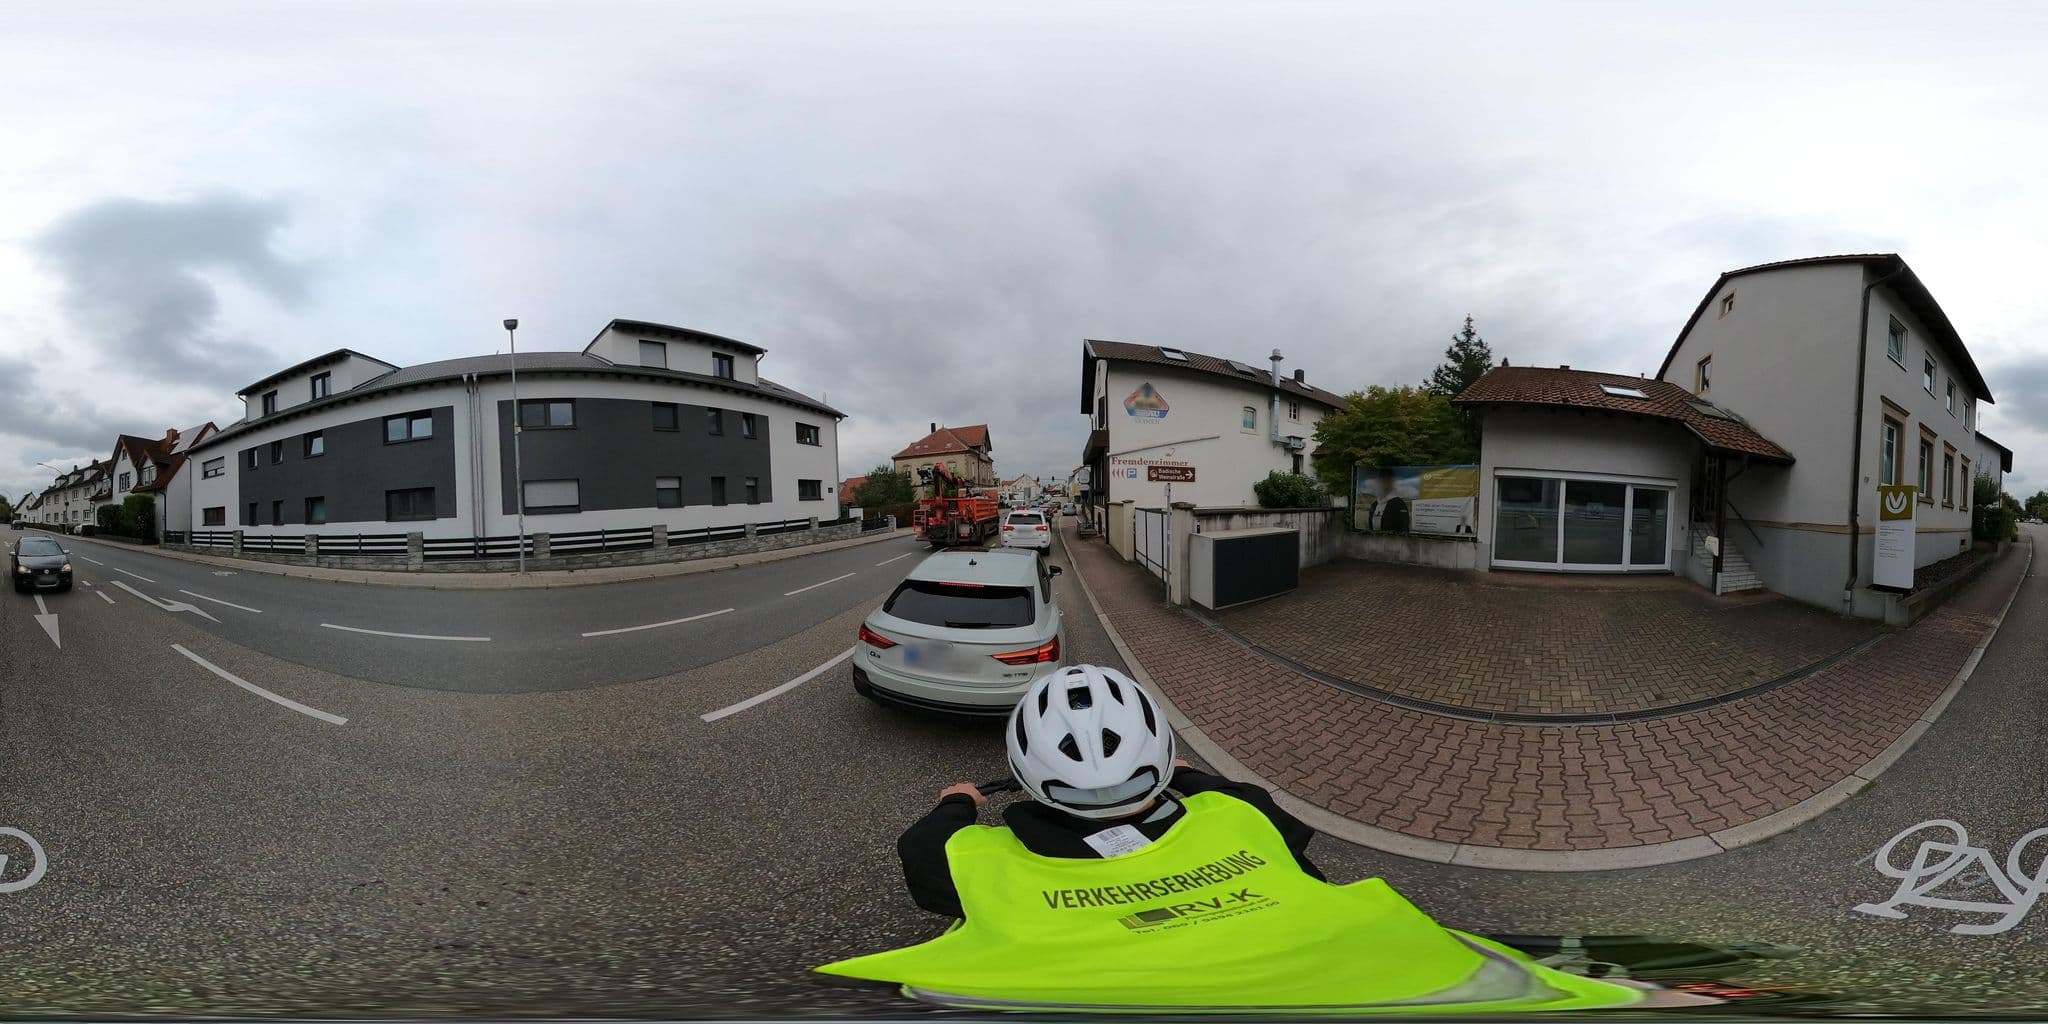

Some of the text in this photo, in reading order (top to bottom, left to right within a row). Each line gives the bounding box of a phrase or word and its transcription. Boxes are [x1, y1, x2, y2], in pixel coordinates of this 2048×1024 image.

[1111, 456, 1189, 467] Fremdenzimmer
[1042, 850, 1267, 909] VERKEHRSERHEBUNG
[1169, 888, 1264, 916] RV-K
